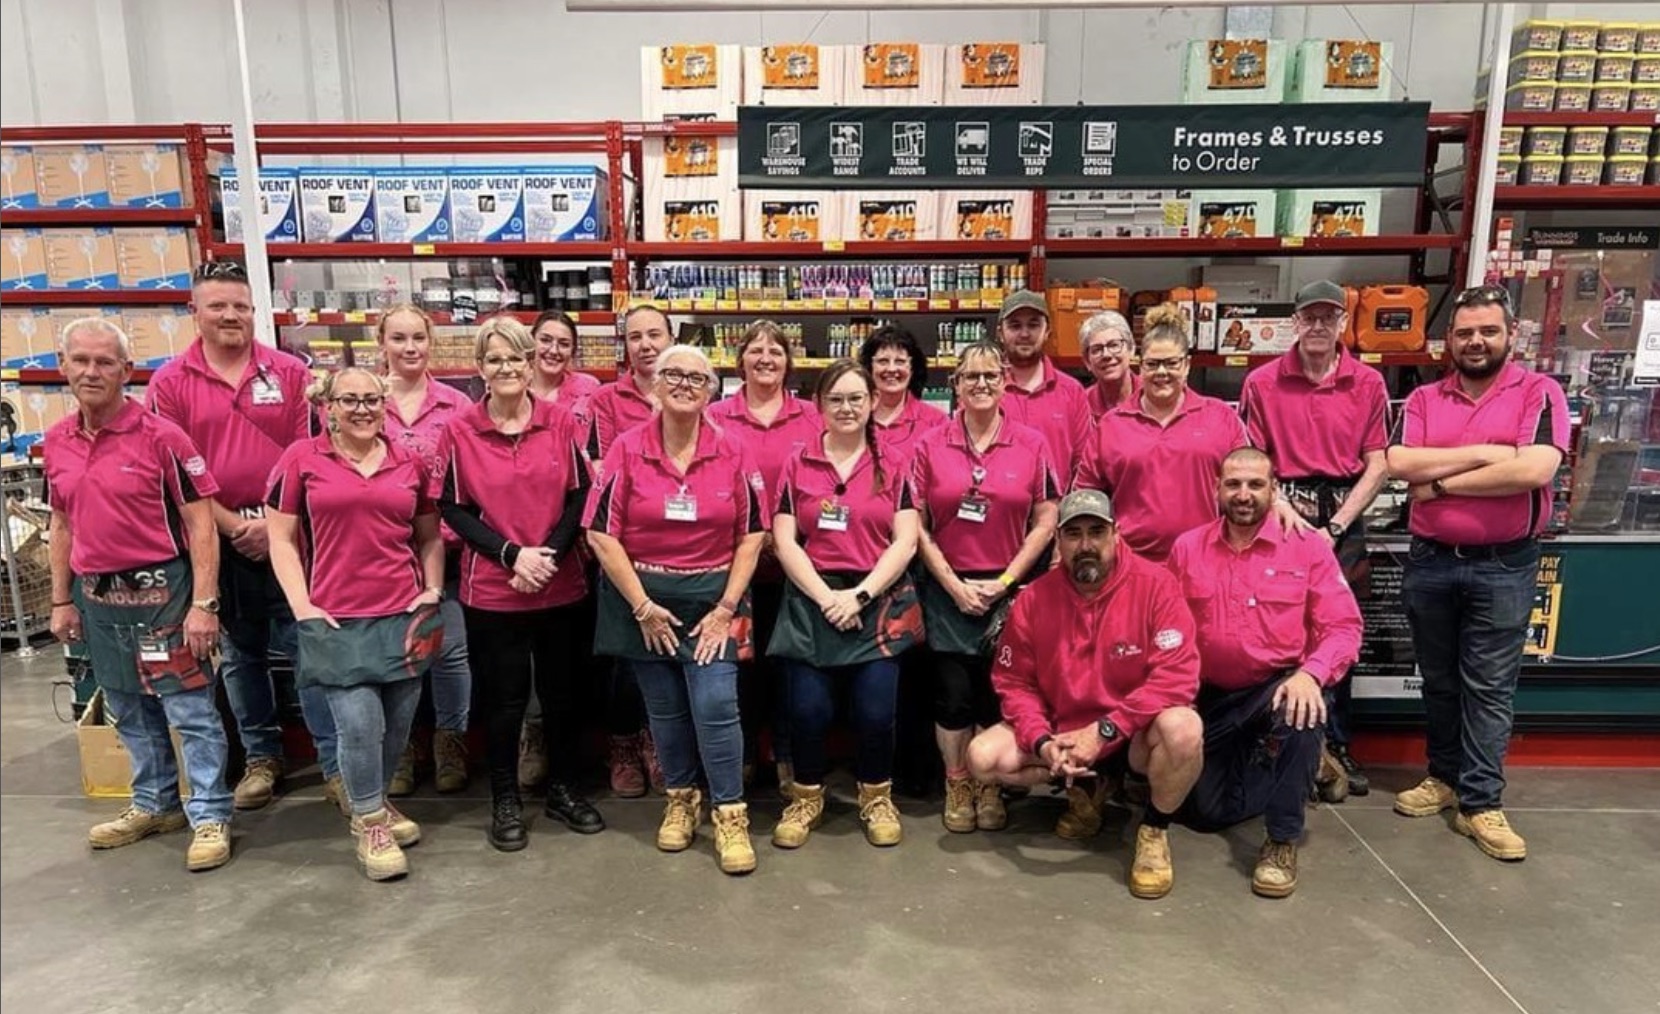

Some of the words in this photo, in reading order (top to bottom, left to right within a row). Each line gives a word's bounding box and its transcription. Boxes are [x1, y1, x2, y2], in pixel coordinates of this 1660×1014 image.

[1173, 127, 1264, 147] Frames
[1268, 126, 1288, 146] &
[1292, 125, 1384, 146] Trusses
[761, 157, 807, 166] WAREHOUSE
[832, 157, 860, 166] WIDEST
[896, 157, 920, 166] TRADE
[956, 157, 968, 166] WE
[969, 157, 988, 166] WILL
[1023, 157, 1047, 166] TRADE
[1083, 157, 1113, 166] SPECIAL
[1171, 153, 1191, 171] to
[1195, 148, 1261, 171] Order
[767, 166, 800, 175] SAVINGS
[833, 166, 859, 175] RANGE
[888, 166, 927, 175] ACCOUNTS
[956, 166, 986, 175] DELIVER
[1025, 166, 1044, 175] REPS
[1083, 166, 1113, 175] ORDERS
[223, 180, 239, 192] RO
[259, 180, 291, 192] VENT
[302, 178, 334, 190] ROOF
[337, 178, 369, 190] VENT
[377, 179, 409, 191] ROOF
[413, 178, 444, 190] VENT
[452, 178, 484, 190] ROOF
[487, 177, 519, 189] VENT
[525, 177, 557, 189] ROOF
[560, 177, 593, 188] VENT
[688, 203, 719, 220] 410
[787, 204, 819, 221] 410
[885, 203, 916, 220] 410
[982, 203, 1013, 220] 410
[1222, 205, 1256, 223] 470
[1333, 205, 1366, 222] 470
[1597, 232, 1625, 243] Trade
[1628, 231, 1649, 243] Info
[1541, 556, 1562, 569] PAY
[1536, 570, 1558, 583] AIN
